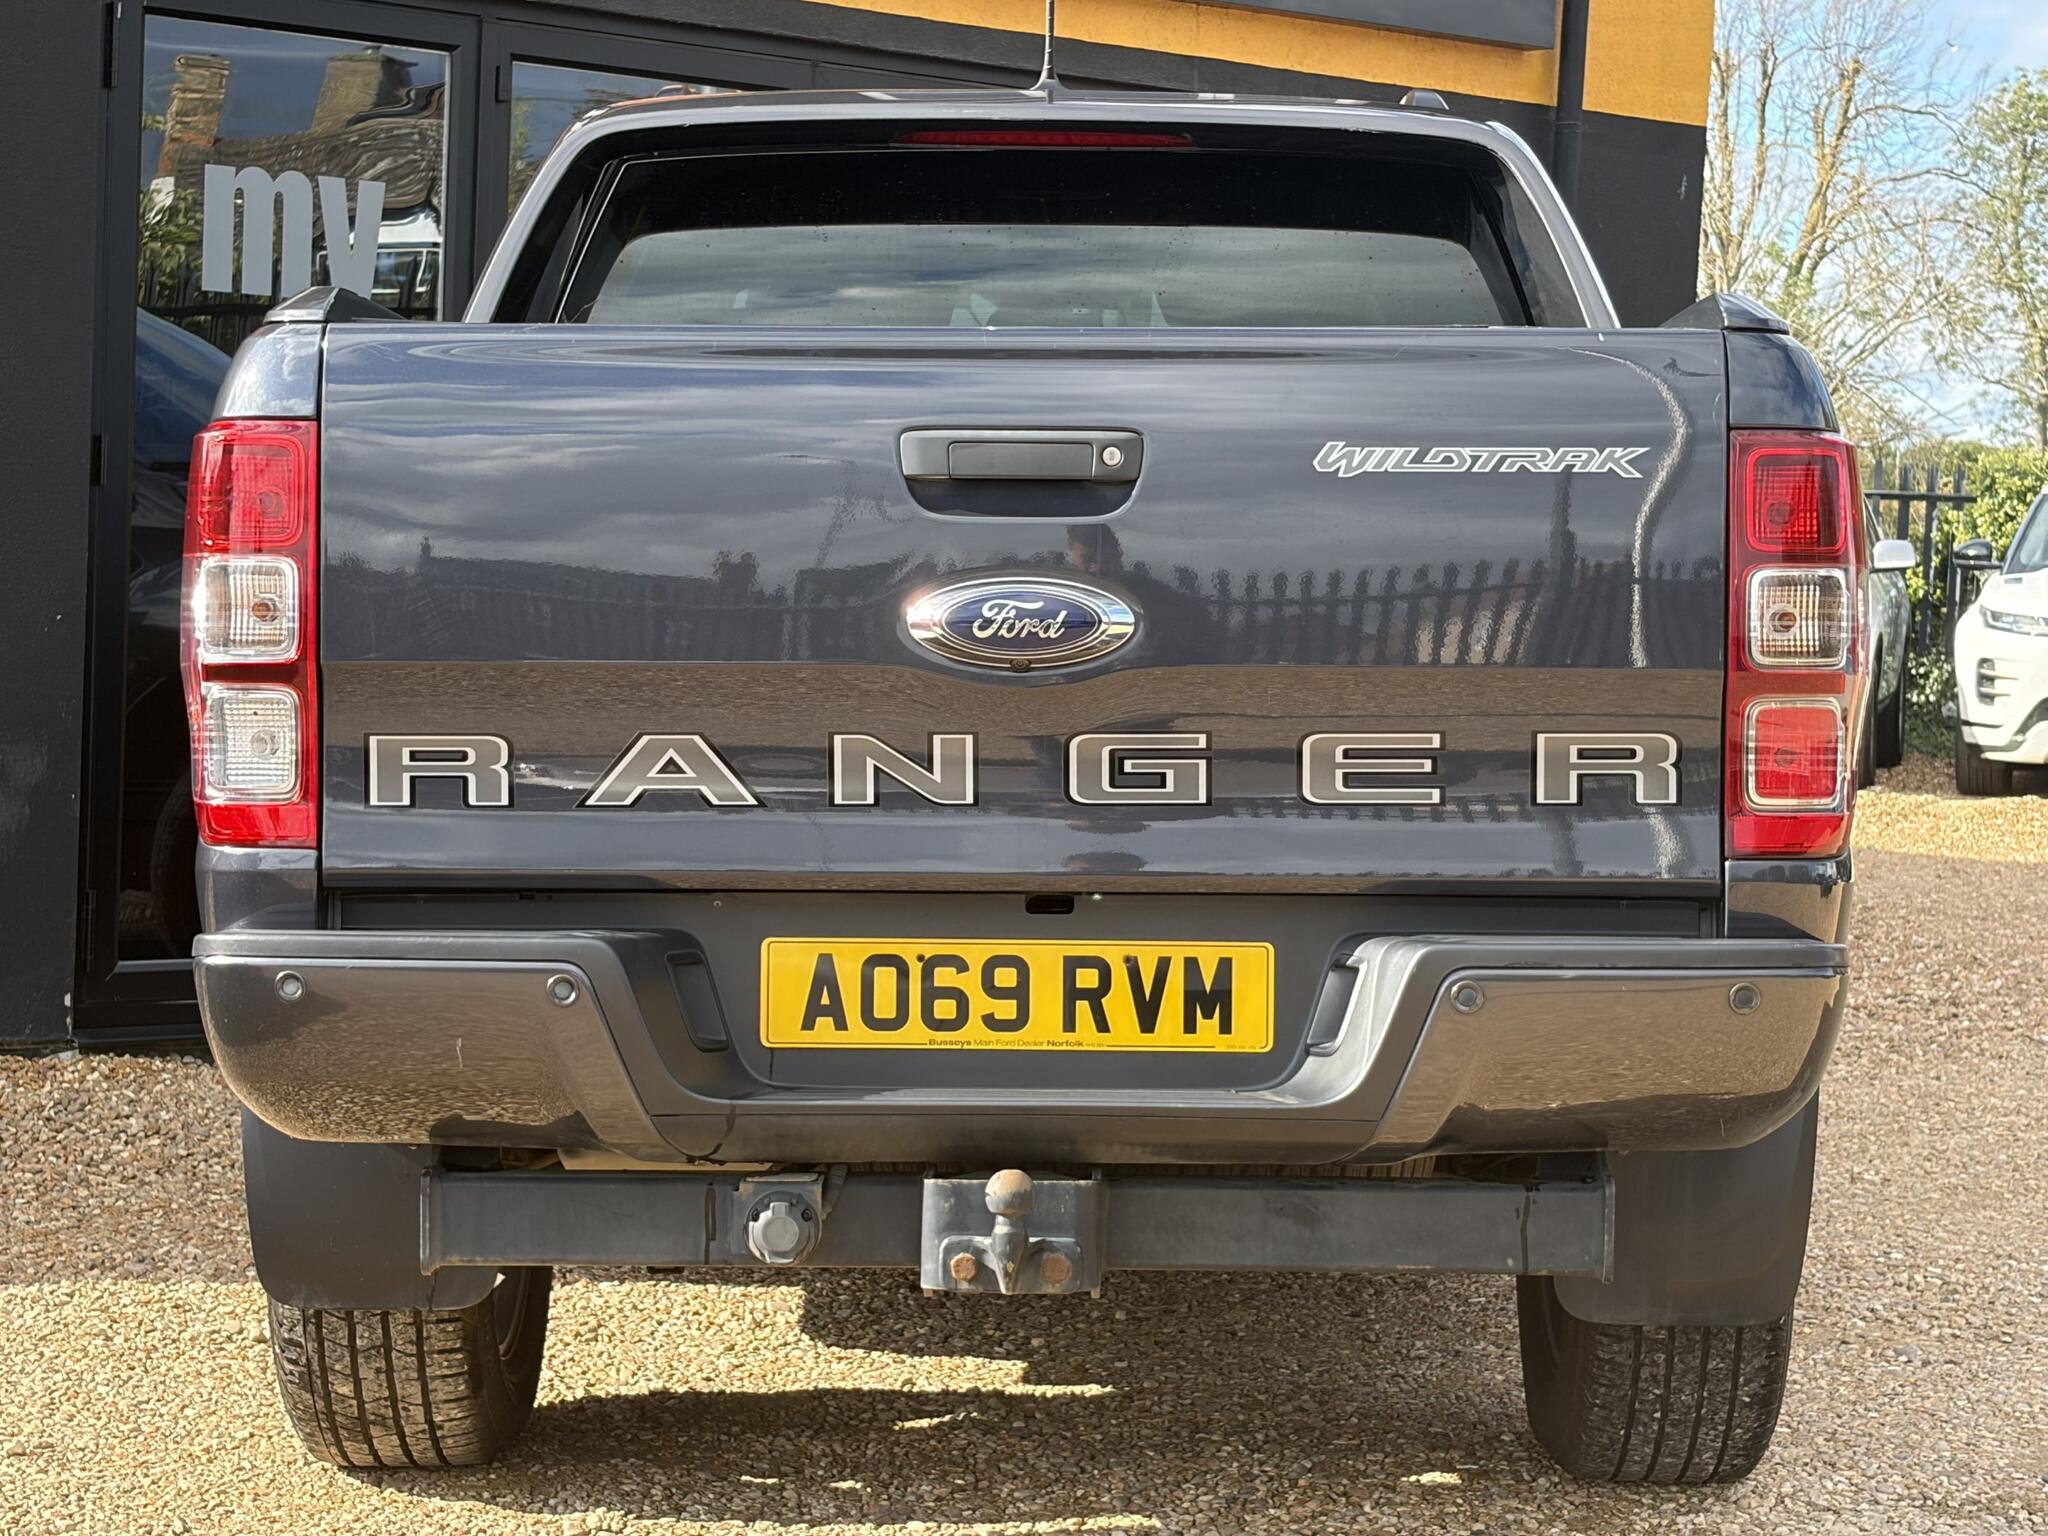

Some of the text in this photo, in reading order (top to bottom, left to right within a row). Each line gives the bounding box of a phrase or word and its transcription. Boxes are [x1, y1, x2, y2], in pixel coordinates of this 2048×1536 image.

[1312, 441, 1650, 478] WILDTRAK
[972, 598, 1068, 639] Ford
[366, 732, 1680, 807] RANGER
[1062, 955, 1232, 1035] RVM
[995, 1039, 1016, 1047] Ford
[1047, 1039, 1085, 1047] Norfolk
